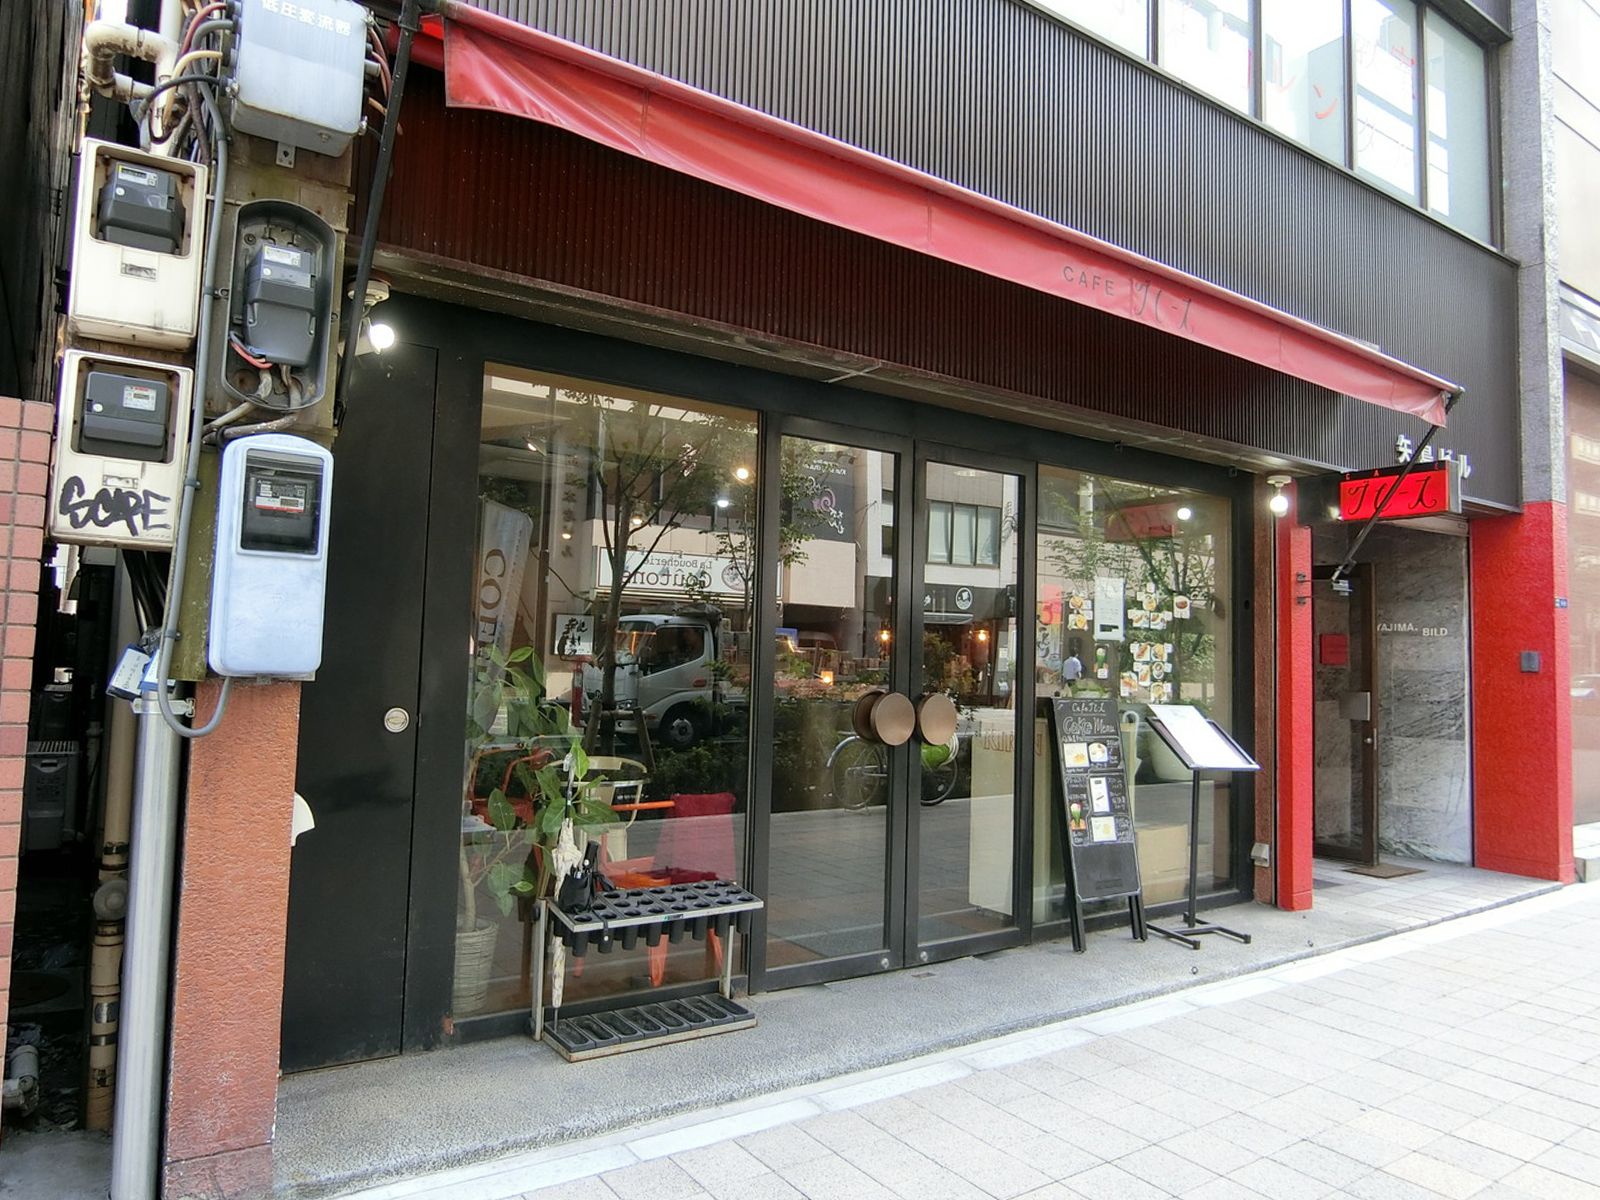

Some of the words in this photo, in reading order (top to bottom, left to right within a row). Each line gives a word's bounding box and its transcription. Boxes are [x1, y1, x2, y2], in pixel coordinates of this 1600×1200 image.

[1063, 265, 1114, 297] CAFE
[1422, 627, 1448, 637] BILD
[1062, 716, 1093, 736] Cake
[1093, 717, 1116, 735] Menu
